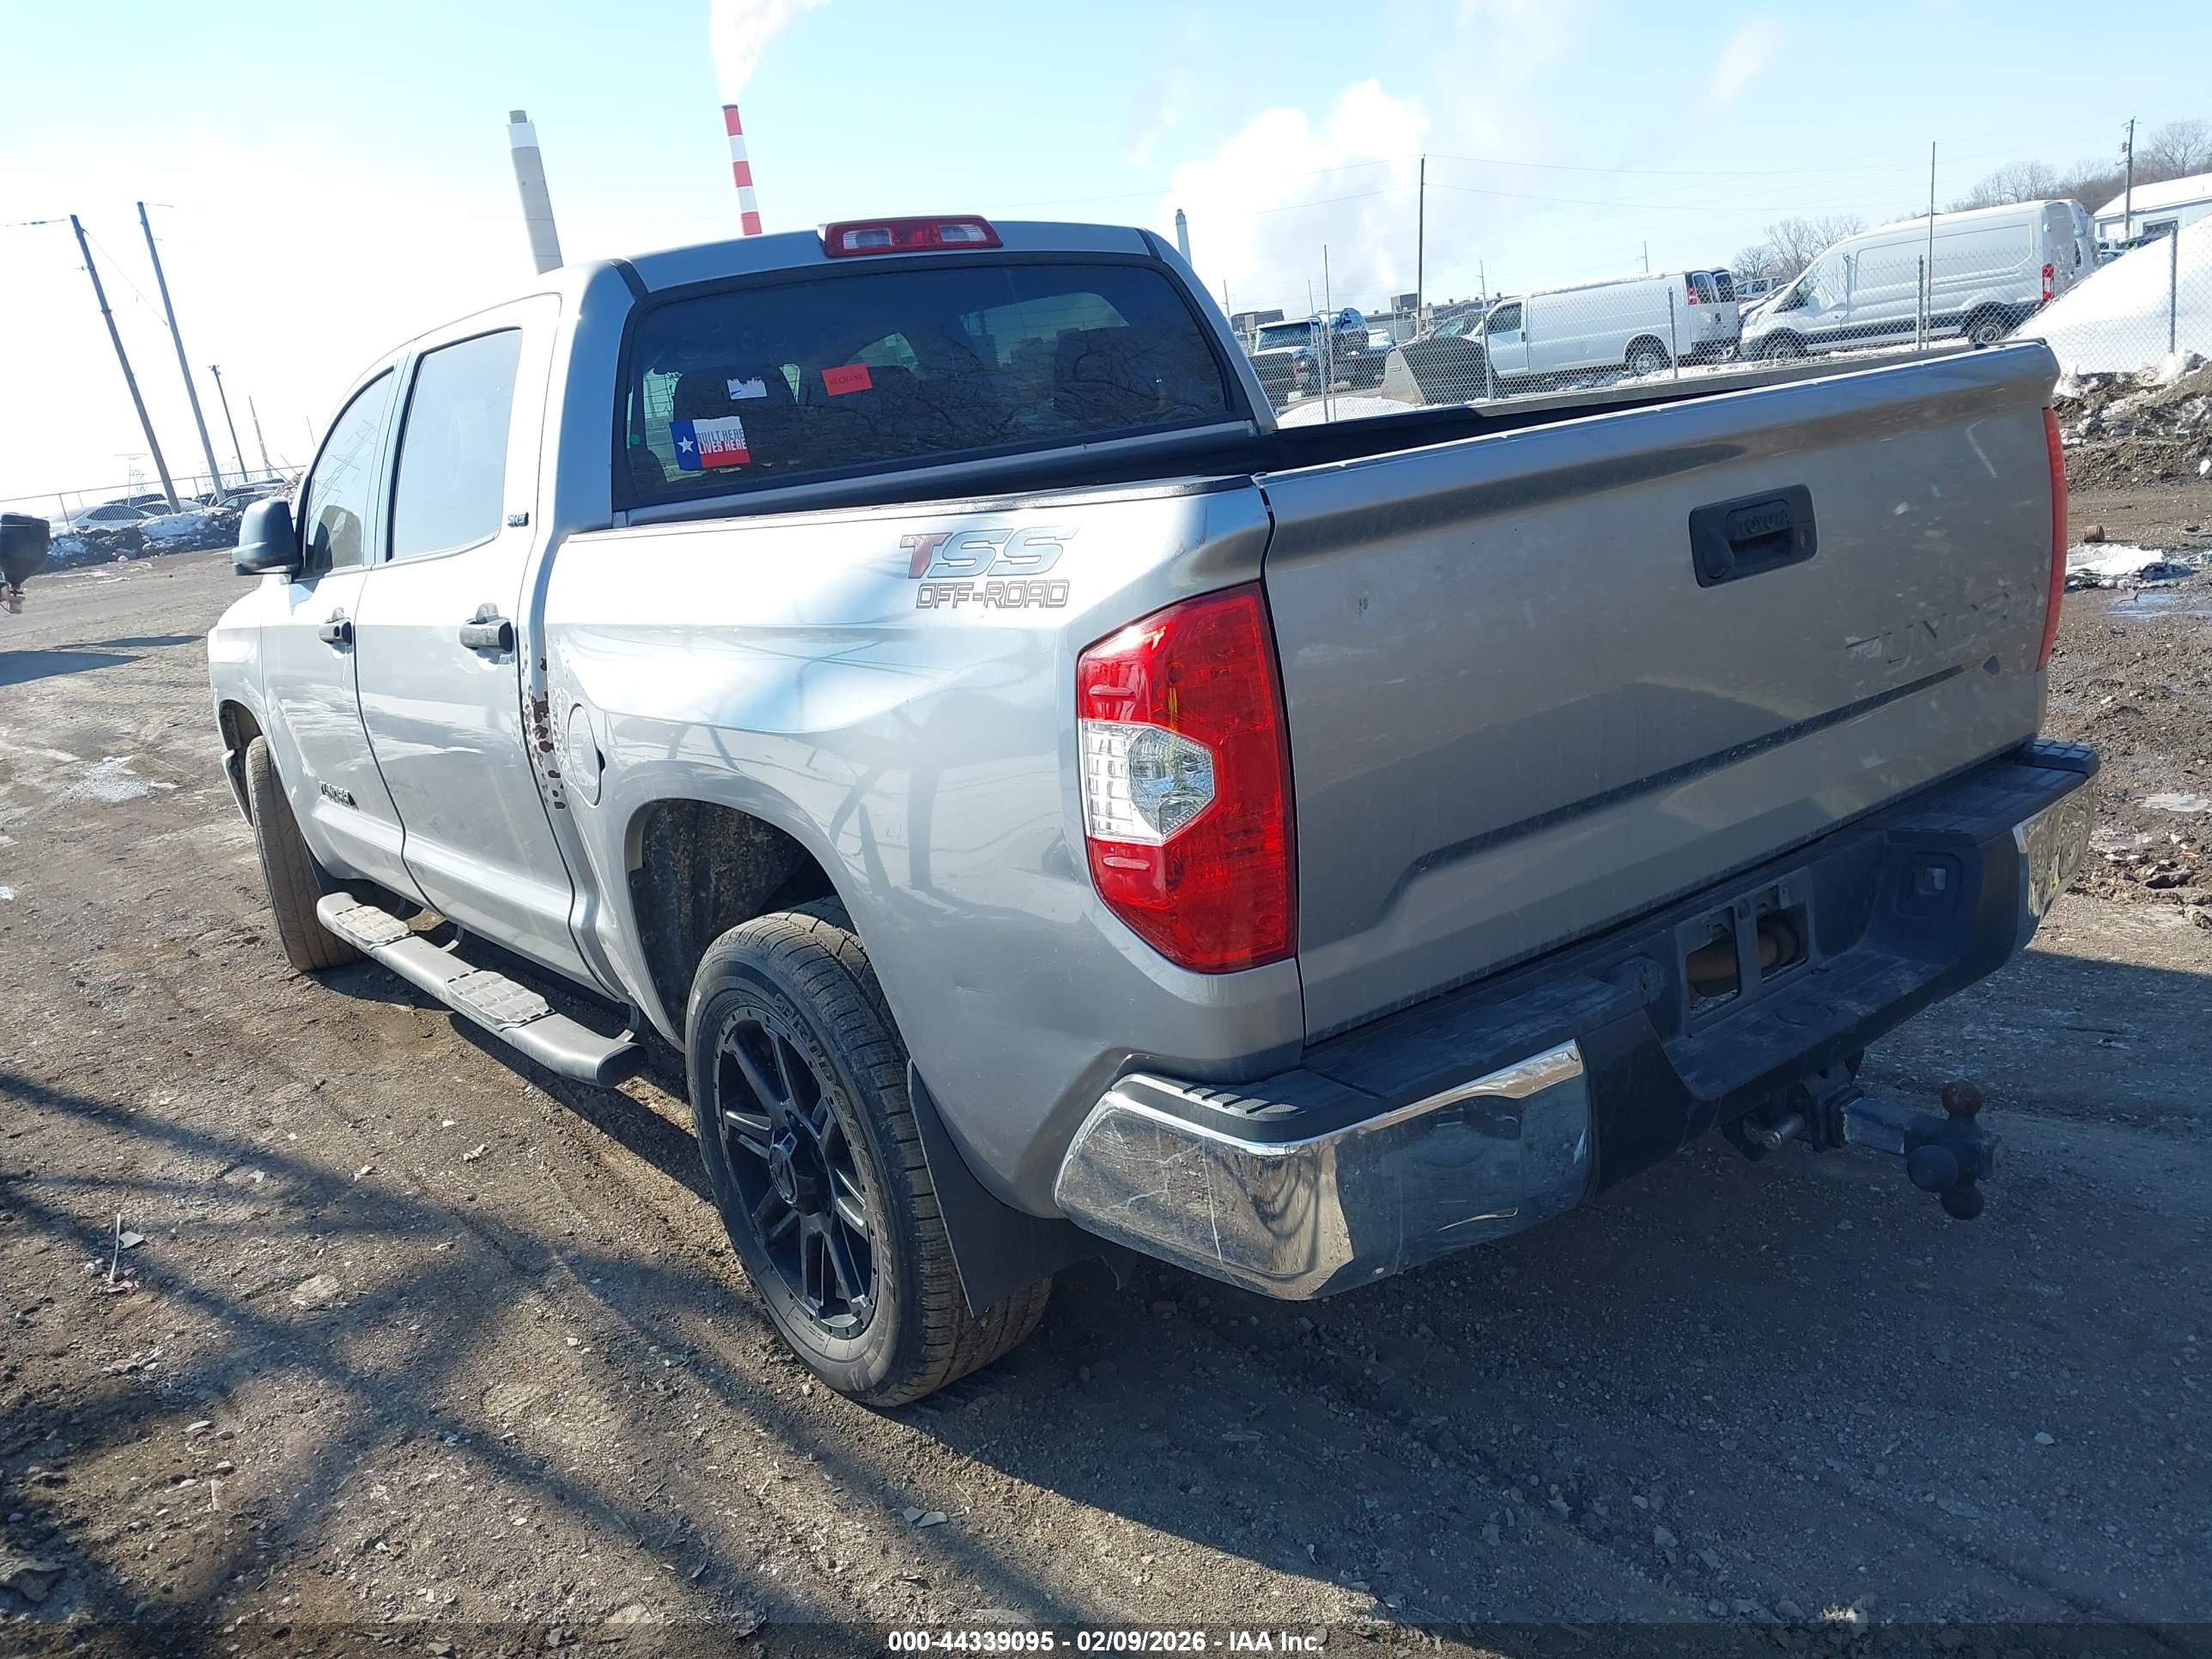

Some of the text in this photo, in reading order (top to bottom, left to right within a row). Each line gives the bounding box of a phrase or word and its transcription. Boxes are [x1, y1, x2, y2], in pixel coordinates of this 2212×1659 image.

[696, 428, 745, 445] BUILT HERE
[699, 438, 748, 454] LIVES HERE
[900, 526, 1080, 580] TSS
[915, 580, 1070, 610] OFF-ROAD
